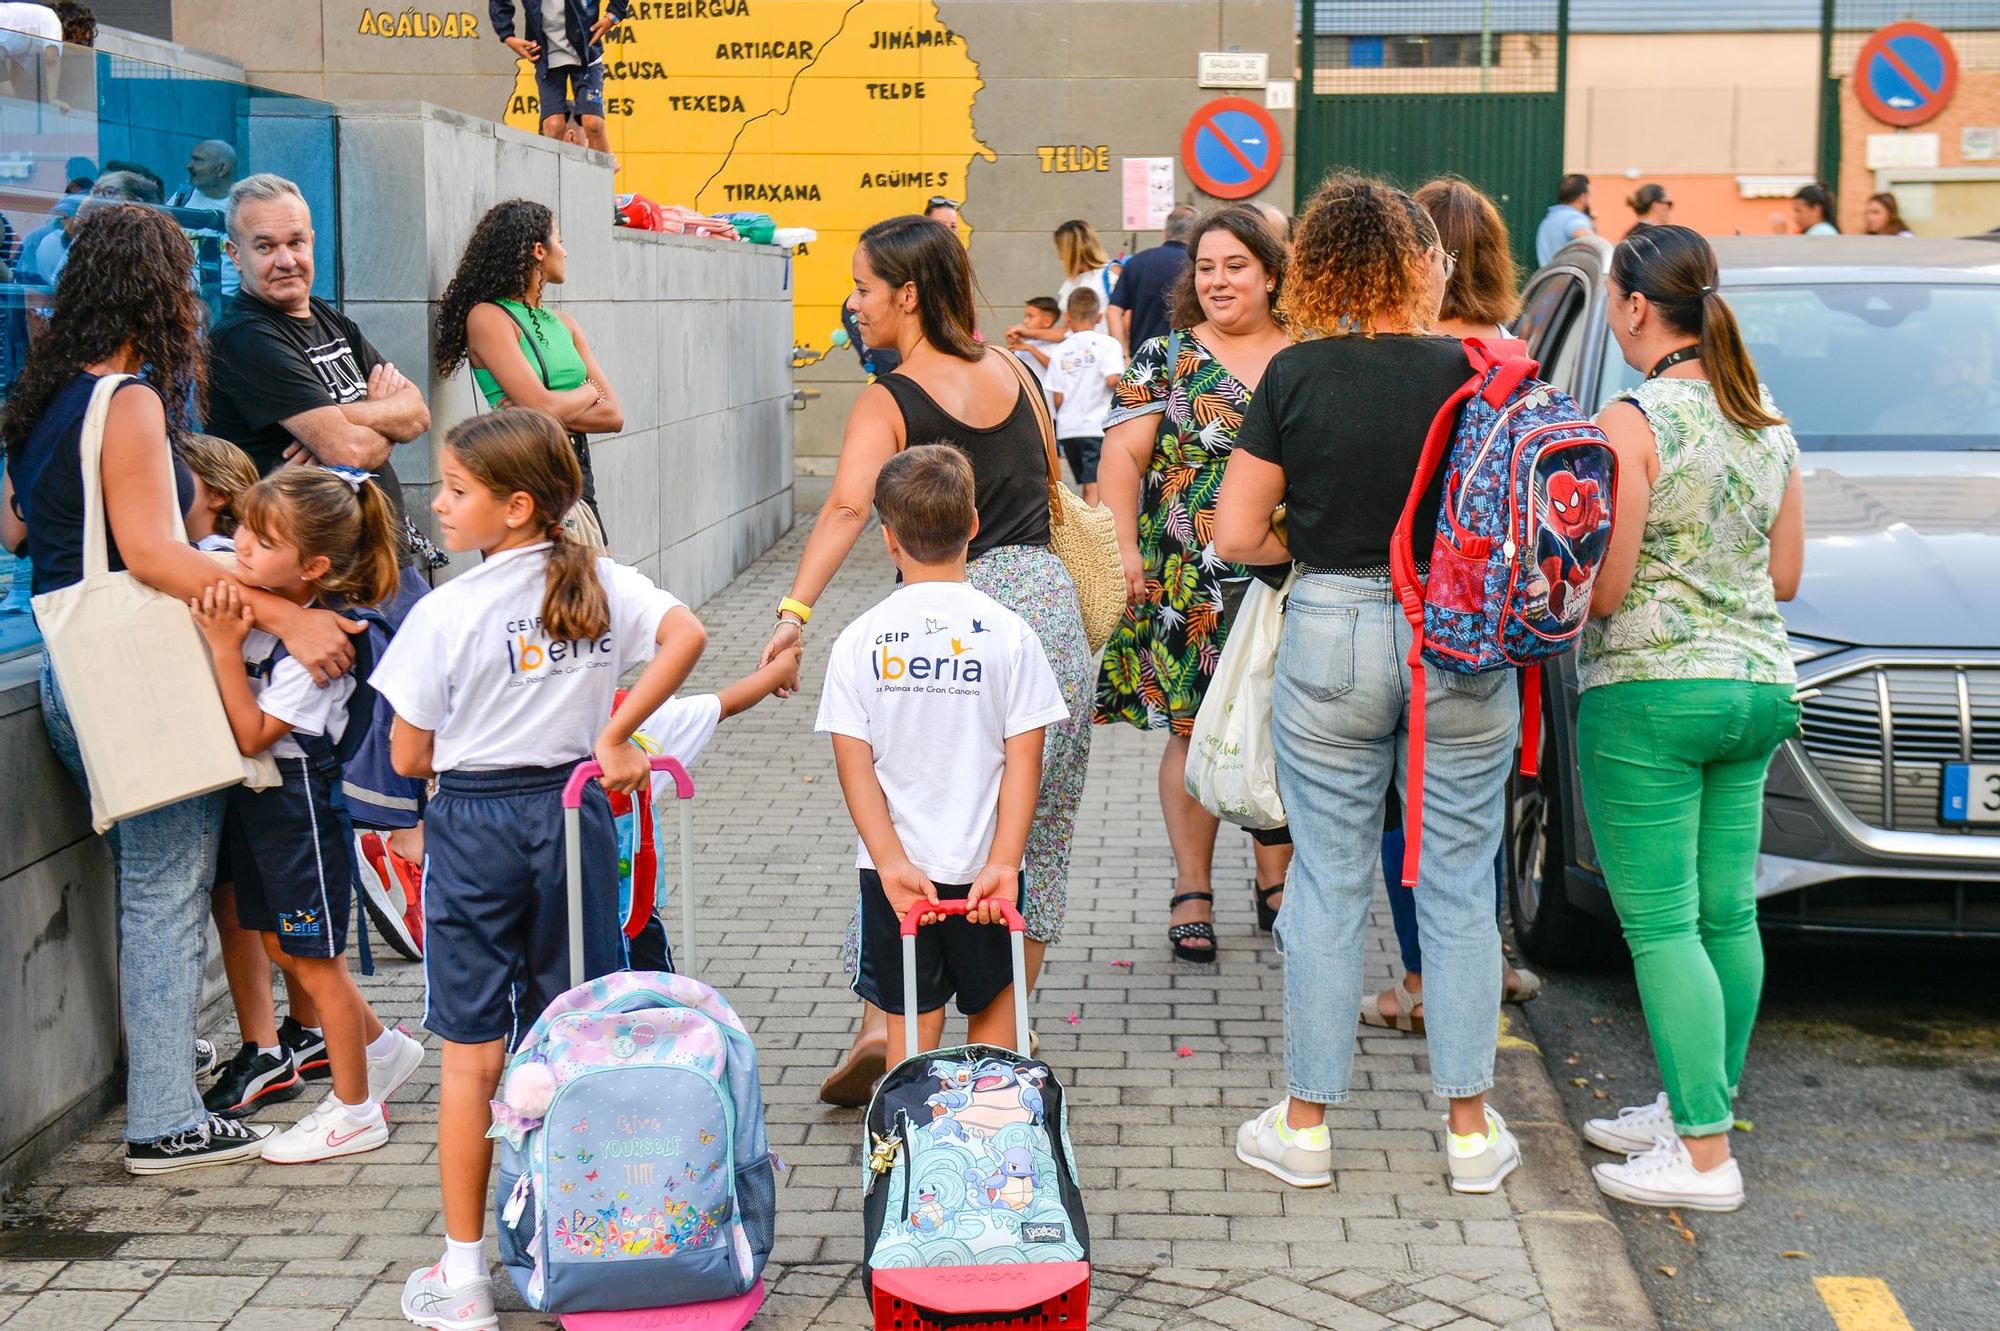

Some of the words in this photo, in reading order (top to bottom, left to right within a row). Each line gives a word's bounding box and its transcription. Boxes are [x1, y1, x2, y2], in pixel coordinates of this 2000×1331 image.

[869, 26, 957, 49] JINÁMAR
[715, 40, 814, 60] ARTIACAR
[865, 82, 926, 100] TELDE
[669, 95, 746, 113] TEXEDA
[1036, 145, 1111, 173] TELDE
[860, 170, 949, 188] AGÜIMES
[723, 184, 821, 202] TIRAXANA
[875, 632, 910, 645] CEIP
[601, 1135, 681, 1159] YOURSELF
